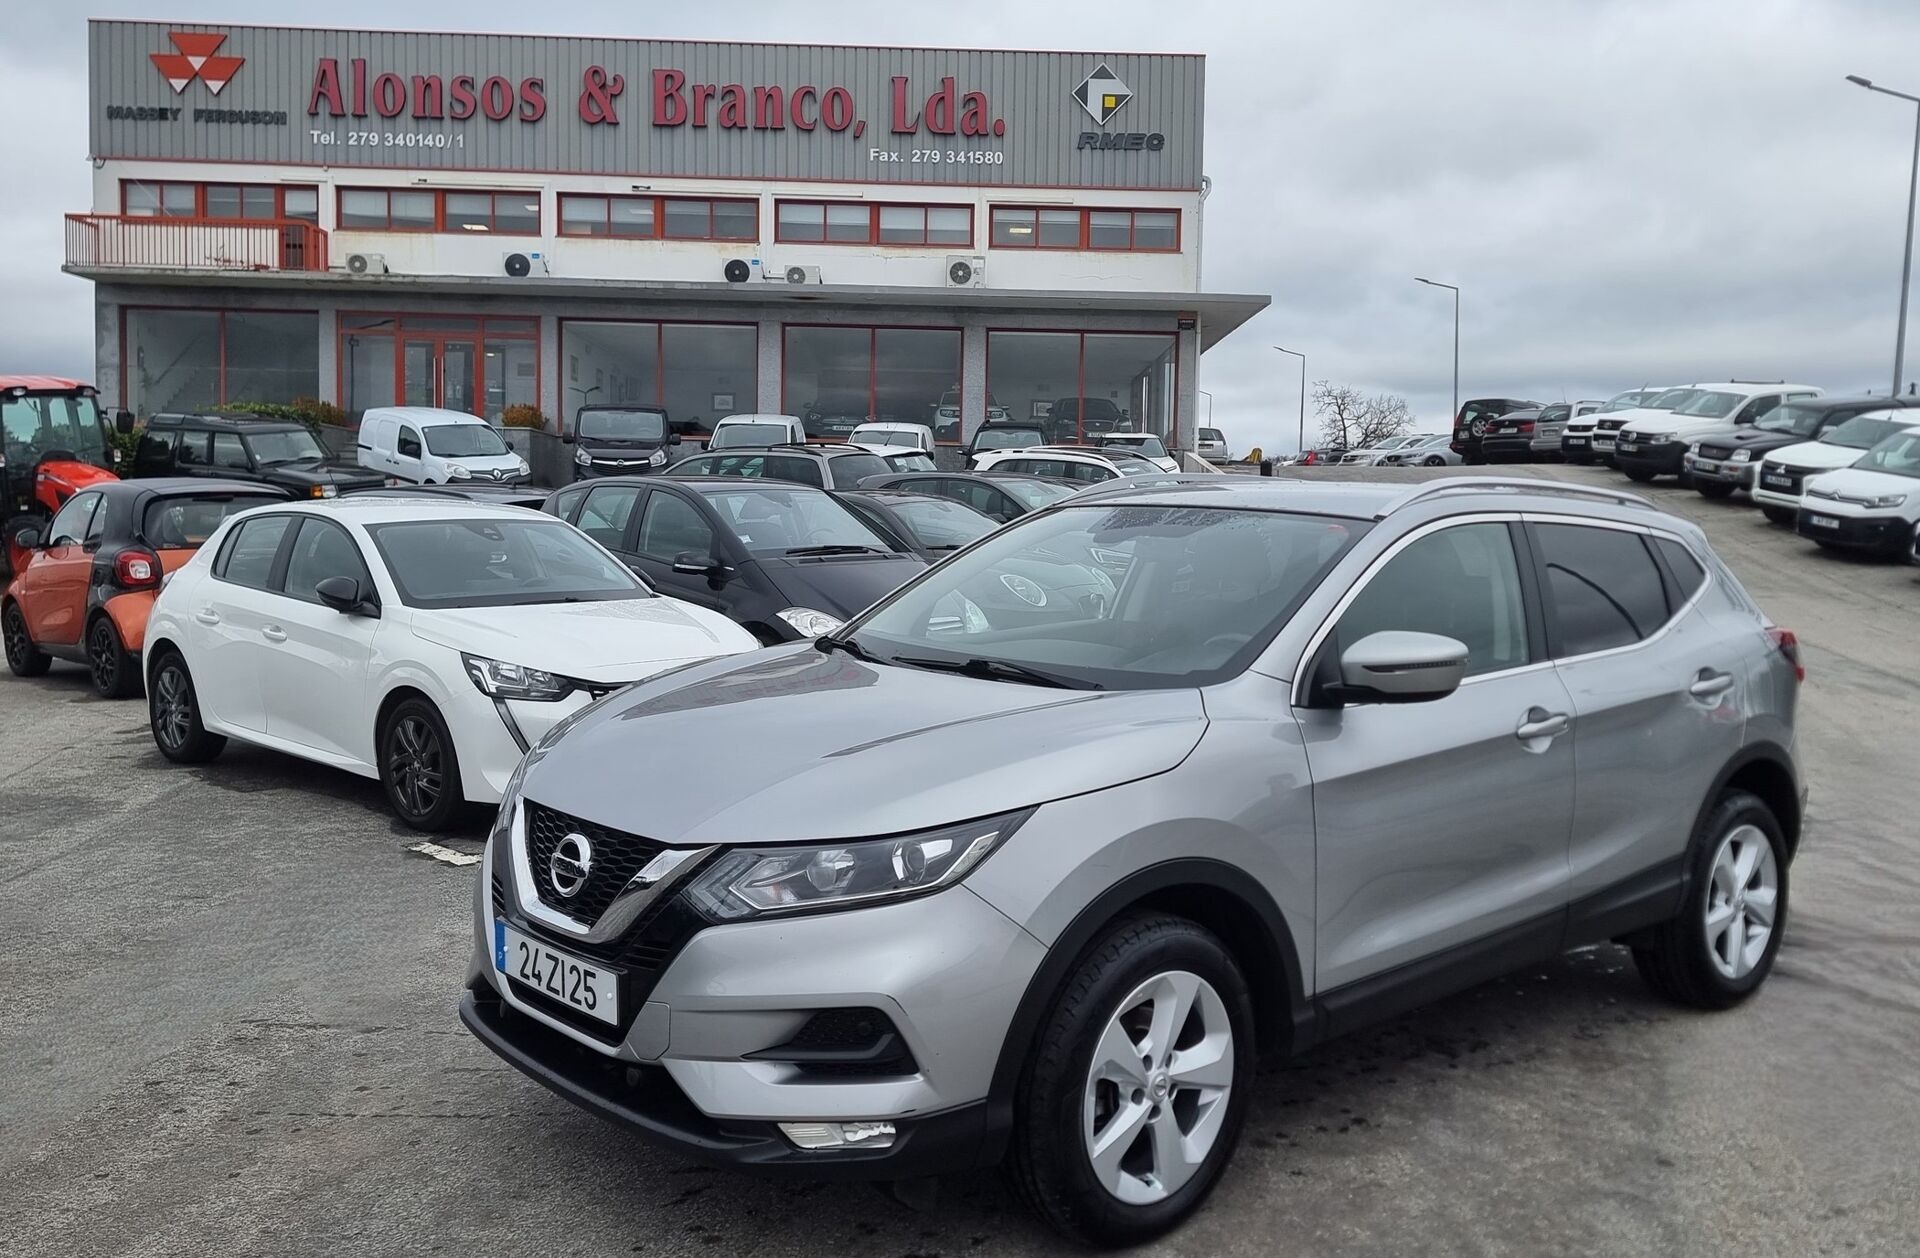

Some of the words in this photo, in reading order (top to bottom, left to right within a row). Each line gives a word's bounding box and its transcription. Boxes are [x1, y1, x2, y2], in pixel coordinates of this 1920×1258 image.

[307, 58, 546, 122] Alonsos
[579, 65, 625, 124] &
[652, 68, 866, 138] Branco,
[891, 76, 1006, 137] Lda.
[107, 105, 181, 121] MASSEY
[193, 108, 288, 126] FERGUSON
[310, 130, 341, 145] Tel.
[348, 131, 379, 146] 279
[384, 132, 464, 149] 340140/1
[1077, 131, 1165, 151] RMEC
[869, 148, 904, 162] Fax.
[911, 149, 941, 163] 279
[946, 150, 1004, 165] 341580
